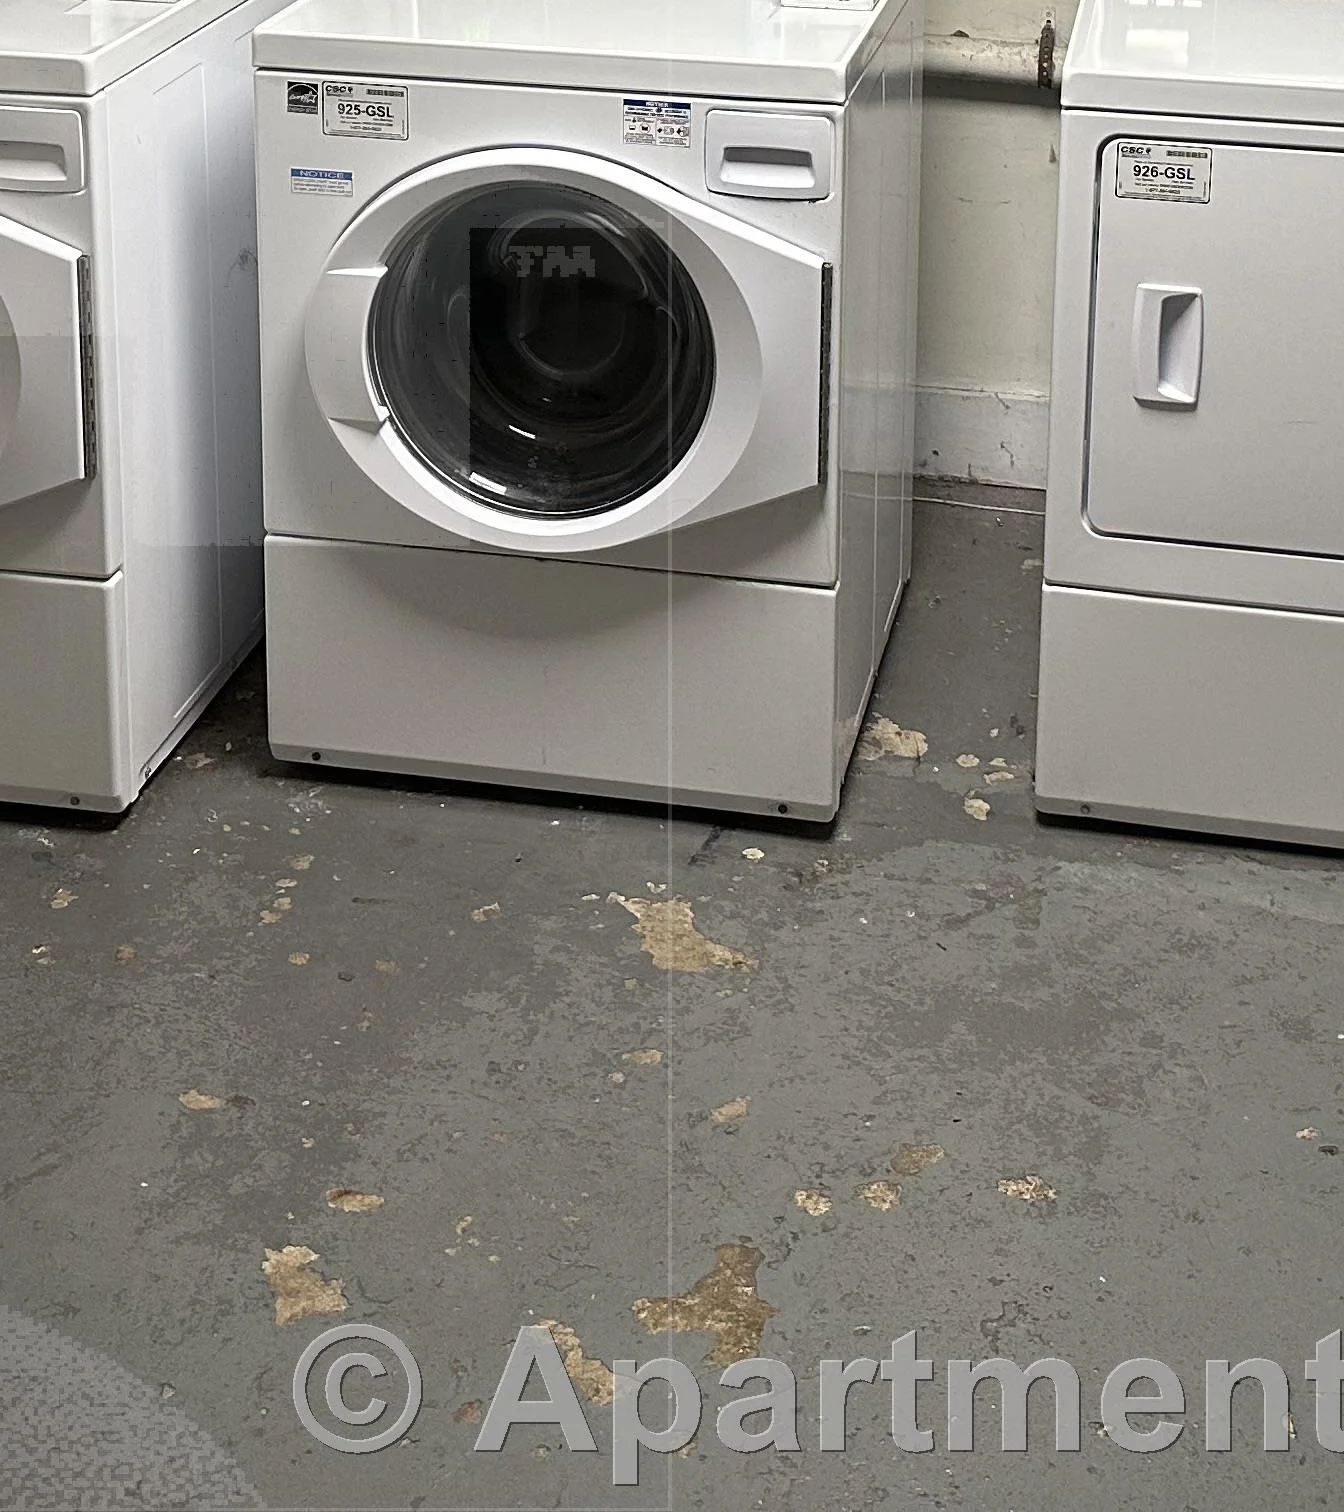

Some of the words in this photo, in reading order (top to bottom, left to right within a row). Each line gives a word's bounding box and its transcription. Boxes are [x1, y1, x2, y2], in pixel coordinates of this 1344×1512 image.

[337, 102, 395, 118] 925-GSL
[1120, 145, 1144, 154] CSC
[299, 169, 345, 179] NOTICE
[1132, 164, 1196, 181] 926-GSL
